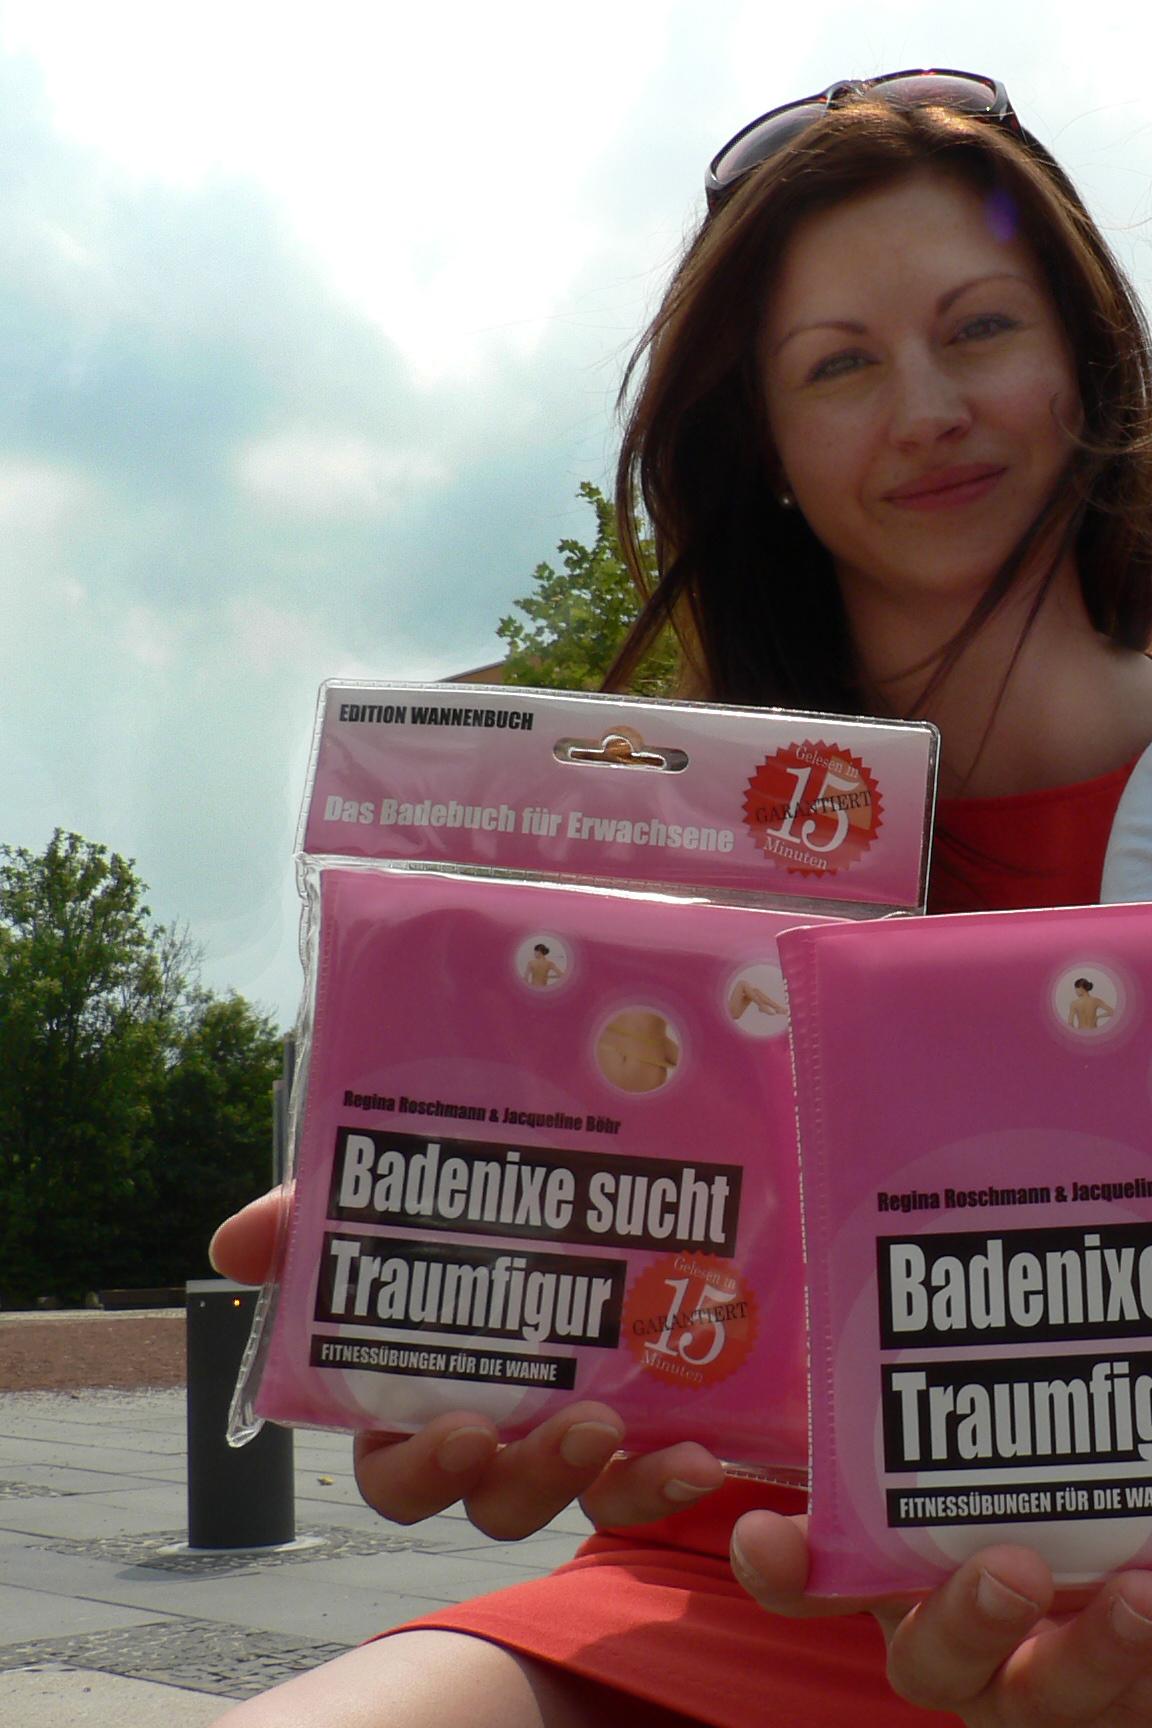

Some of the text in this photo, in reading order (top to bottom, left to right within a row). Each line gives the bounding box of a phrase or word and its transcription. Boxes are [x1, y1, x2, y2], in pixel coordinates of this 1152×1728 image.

[339, 703, 534, 731] EDITION WANNENBUCH
[796, 746, 859, 778] Gelesen in
[324, 796, 734, 853] Das Badebuch für Erwachsene
[756, 791, 872, 823] GARANTIERT
[766, 767, 859, 852] 15
[764, 837, 828, 870] Minuten
[343, 1090, 621, 1135] Regina Roschmann & Jacqueline Böhr
[338, 1134, 730, 1244] Badenixe sucht
[877, 1190, 940, 1213] Regina
[944, 1185, 1051, 1210] Roschmann
[1055, 1186, 1068, 1203] &
[330, 1239, 612, 1342] Traumfigur
[632, 1301, 748, 1336] GARANTIERT
[644, 1278, 737, 1366] 15
[321, 1342, 558, 1381] FITNESSÜBUNGEN FÜR DIE WANNE
[641, 1350, 703, 1383] Minuten
[900, 1489, 1052, 1519] FITNESSÜBUNGEN
[1055, 1488, 1089, 1511] FÜR
[1093, 1487, 1122, 1509] DIE
